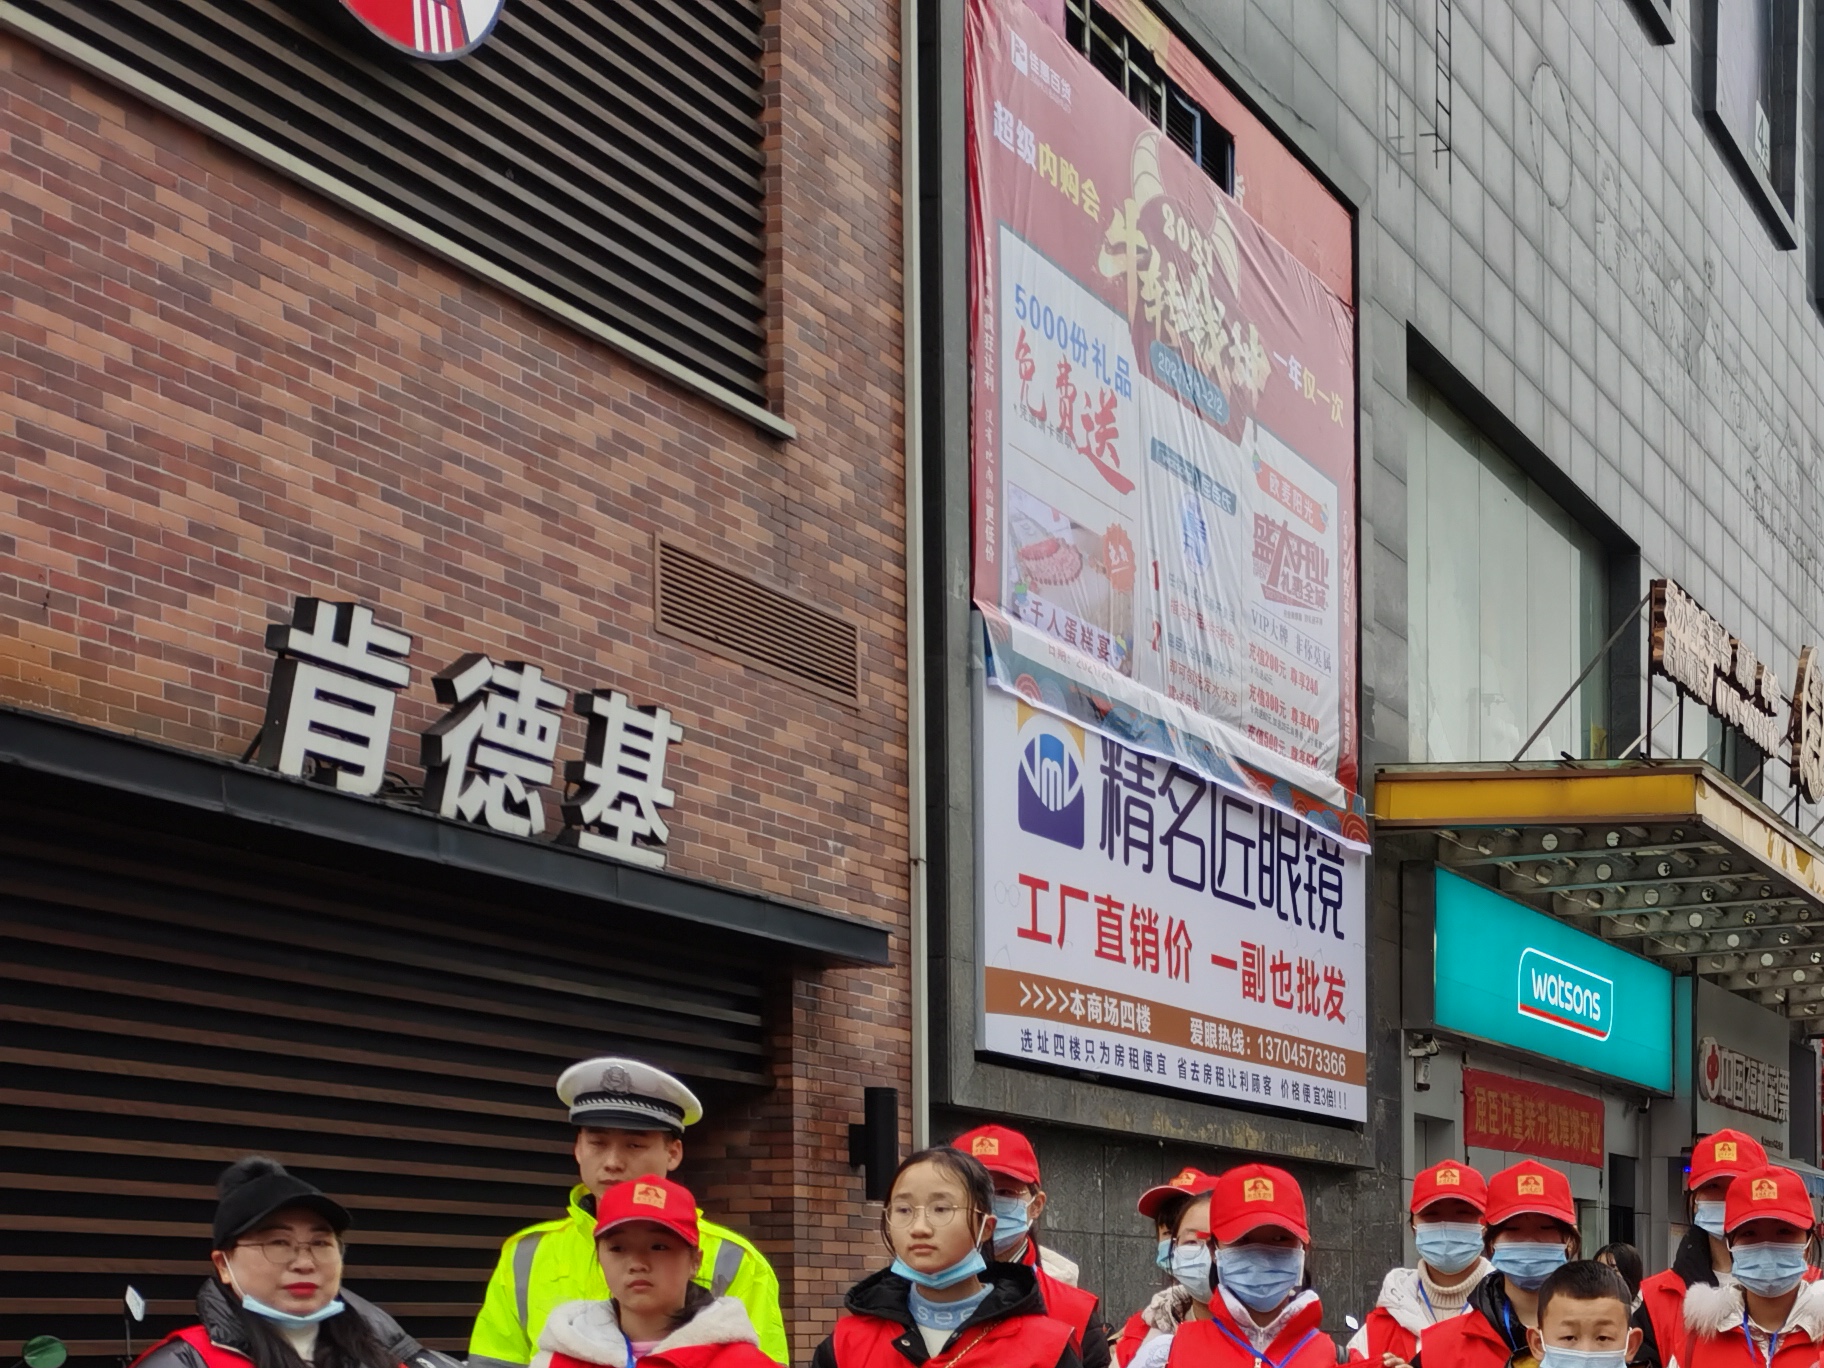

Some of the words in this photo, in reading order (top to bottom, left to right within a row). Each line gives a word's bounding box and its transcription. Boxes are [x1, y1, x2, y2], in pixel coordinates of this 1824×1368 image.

[994, 100, 1100, 222] 超级内购会
[1014, 283, 1133, 402] 5000份礼品
[1014, 325, 1136, 495] 免费送
[1269, 472, 1315, 525] 欧麦阳光
[1030, 600, 1111, 662] 千人蛋糕宴
[1250, 608, 1289, 647] VIP大牌
[1296, 633, 1332, 674] 非你莫属
[268, 598, 684, 869] 肯德基
[1099, 740, 1346, 941] 精名匠眼镜
[1017, 872, 1193, 984] 工厂直销价
[1210, 941, 1347, 1025] 一副也批发
[1070, 989, 1152, 1035] 本商场四楼
[1531, 967, 1601, 1021] watsons
[1020, 1027, 1168, 1076] 选址四楼只为房租便宜
[1177, 1056, 1273, 1097] 省去房租让利顾客
[1721, 1049, 1790, 1123] 中国福利彩票
